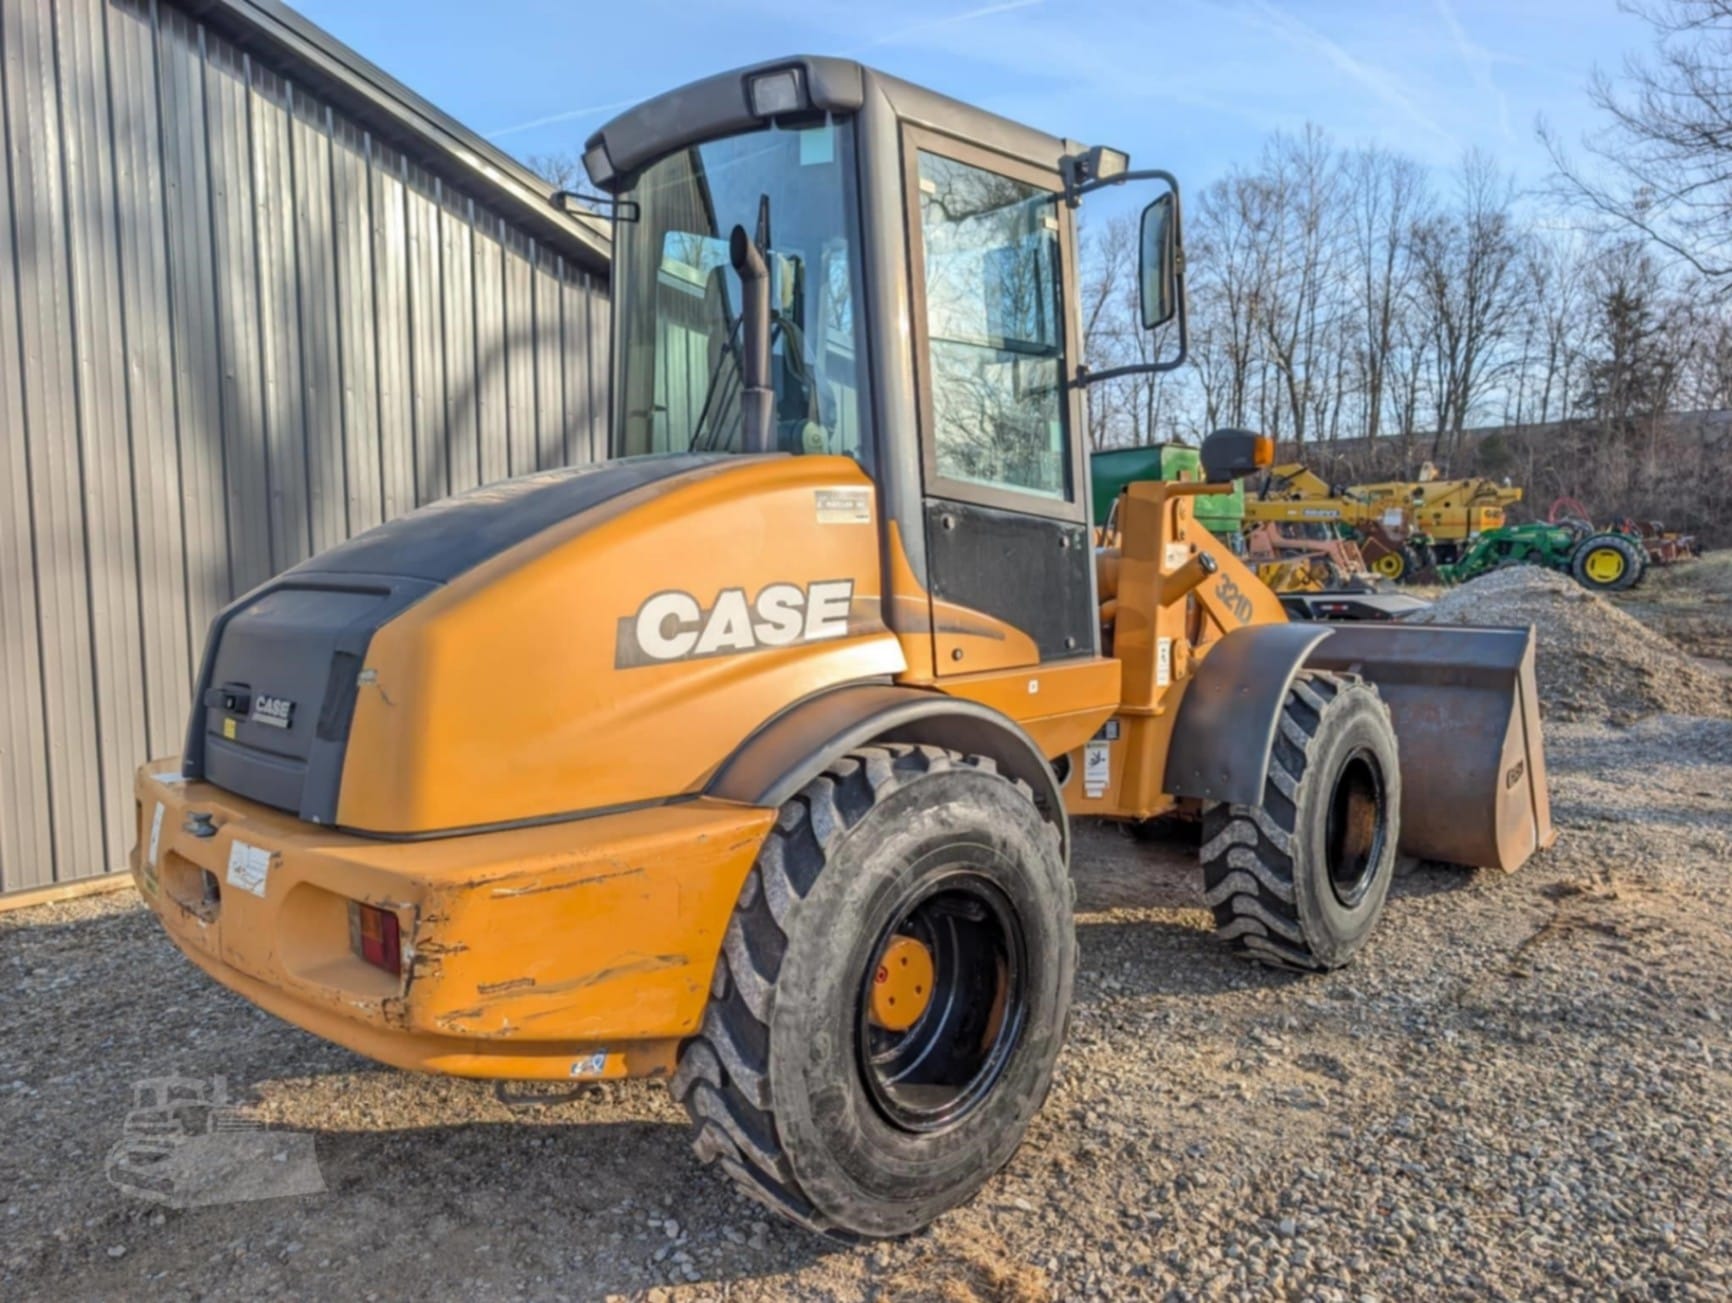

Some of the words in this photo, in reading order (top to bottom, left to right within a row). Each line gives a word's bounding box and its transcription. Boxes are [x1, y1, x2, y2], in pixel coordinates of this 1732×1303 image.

[635, 579, 854, 660] CASE
[1215, 573, 1252, 624] 321D
[255, 696, 290, 718] CASE
